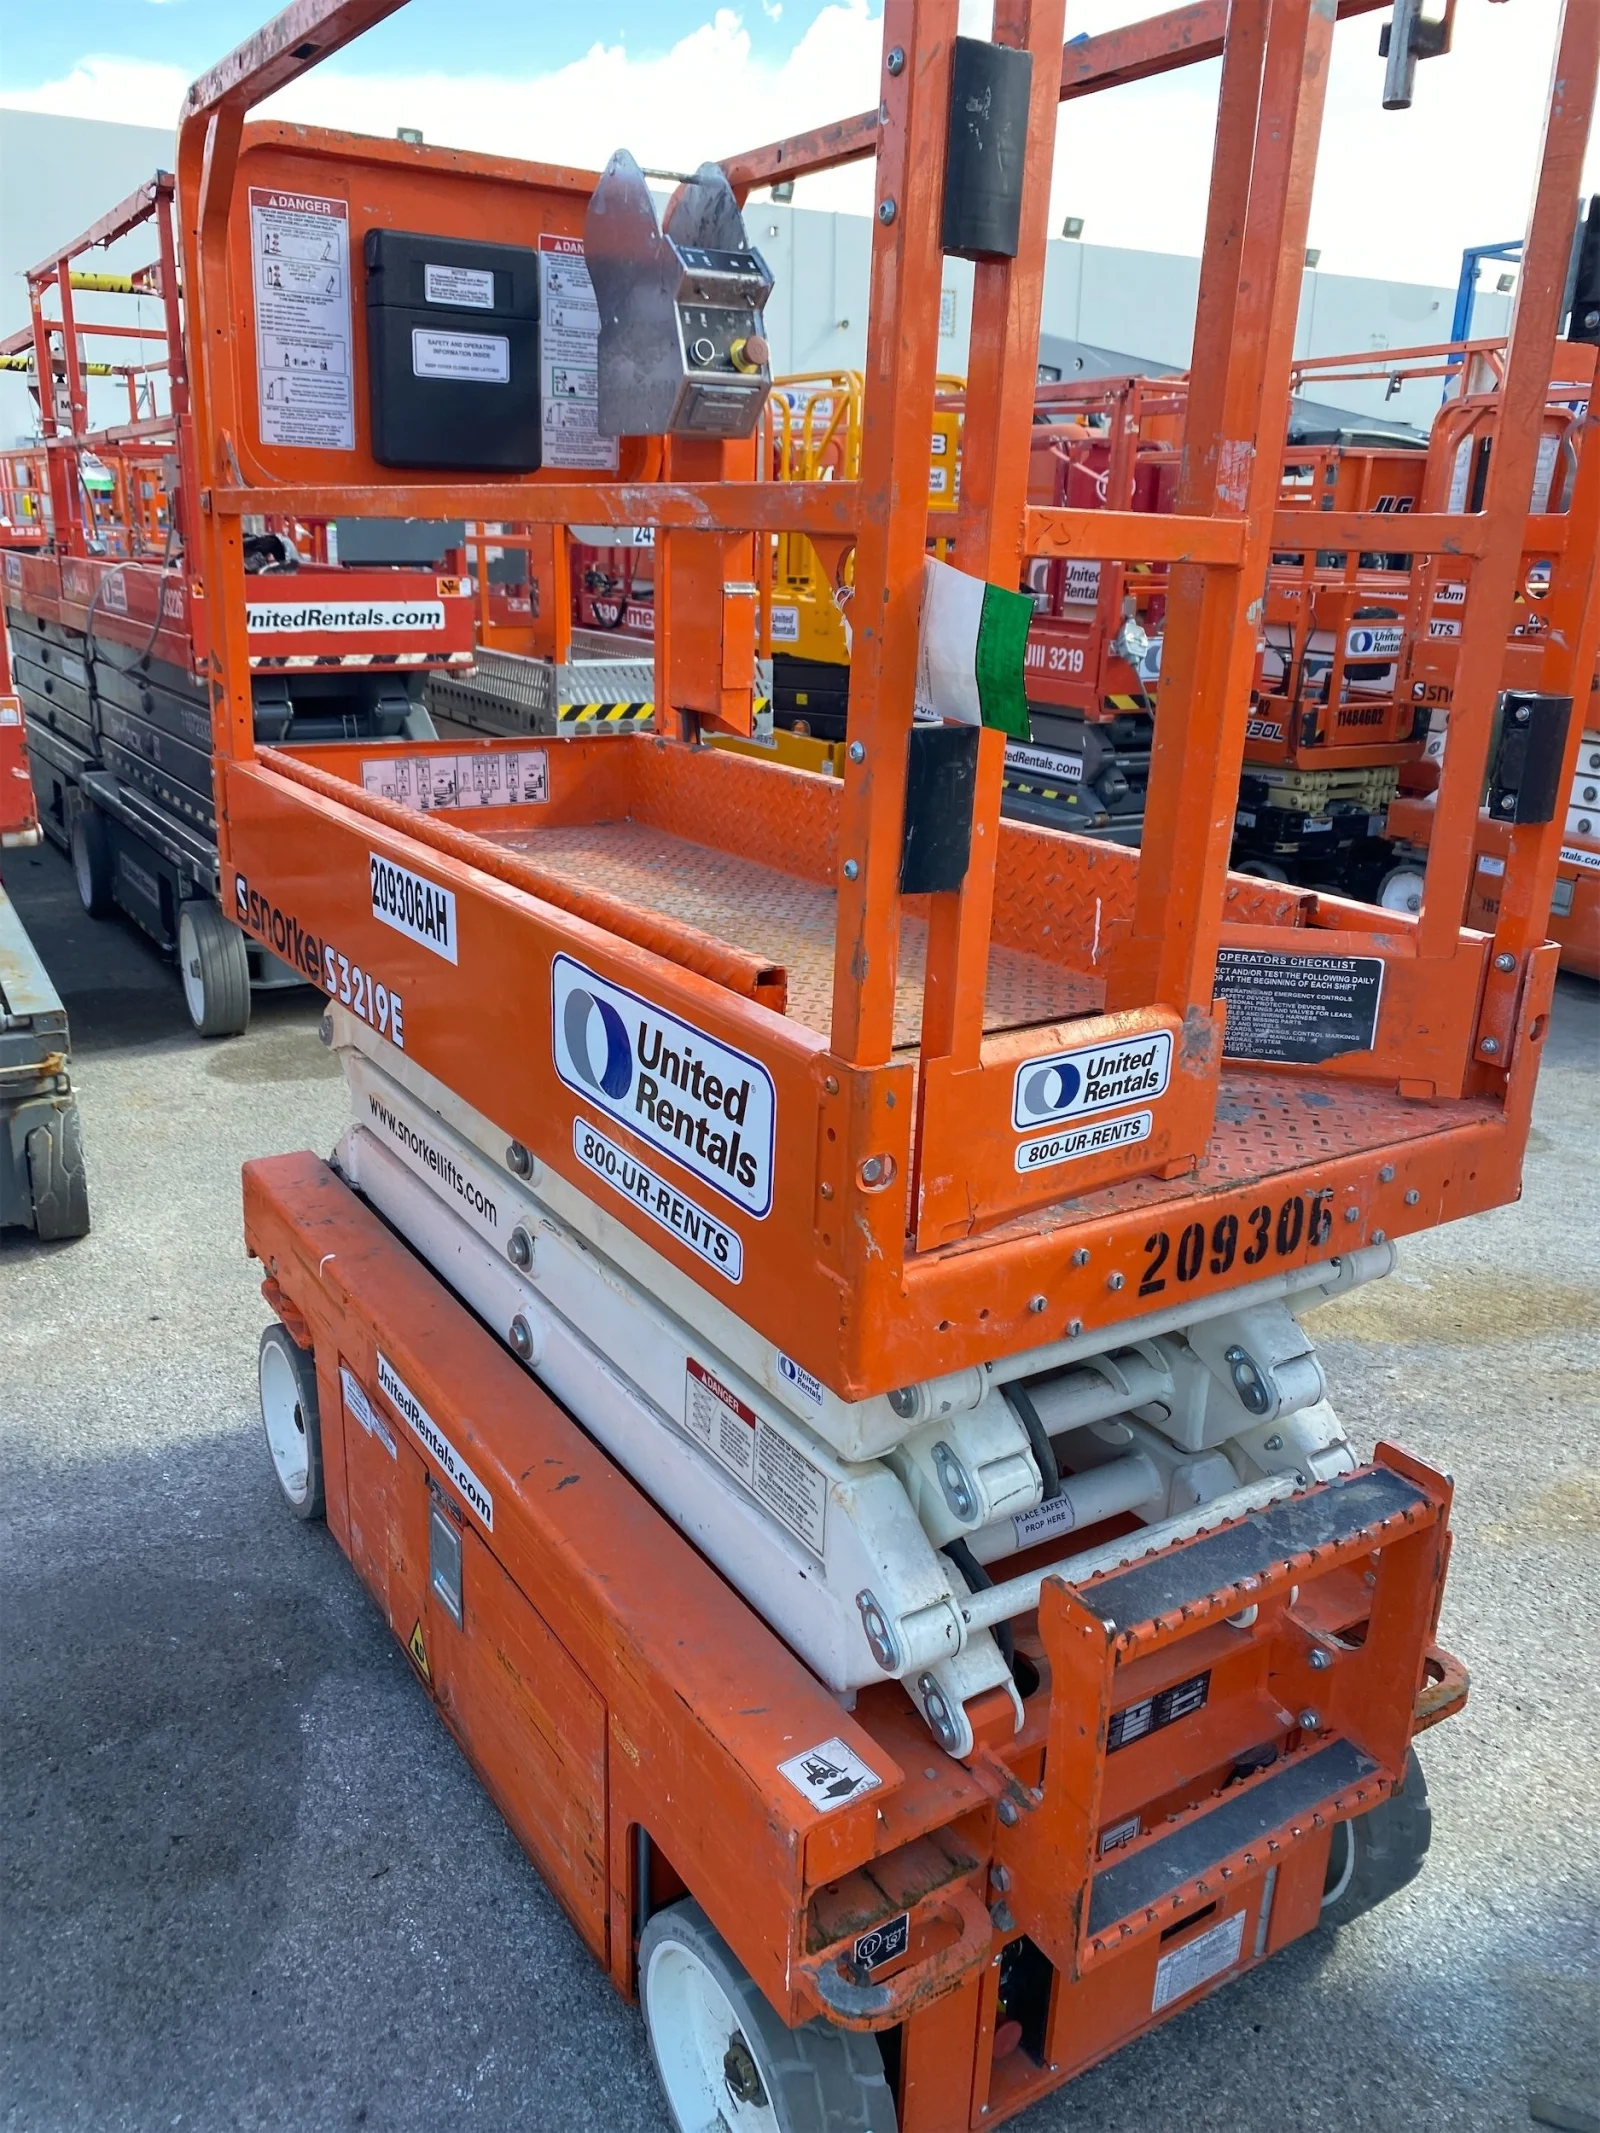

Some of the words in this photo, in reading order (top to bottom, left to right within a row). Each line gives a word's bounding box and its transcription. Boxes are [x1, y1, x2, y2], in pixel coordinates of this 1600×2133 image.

[279, 196, 331, 214] DANGER
[428, 339, 449, 347] SAFETY
[463, 342, 496, 351] OPERATING
[433, 348, 472, 357] INFORMATION
[1048, 646, 1084, 674] 3219
[370, 857, 449, 947] 209306AH
[1219, 952, 1287, 965] OPERATORS
[1290, 957, 1357, 970] CHECKLIST
[1231, 968, 1262, 977] AND/OR
[1264, 970, 1283, 978] TEST
[1285, 972, 1301, 980] THE
[1303, 973, 1350, 983] FOLLOWING
[1352, 976, 1375, 985] DAILY
[1237, 976, 1252, 984] THE
[1253, 977, 1296, 987] BEGINNING
[1298, 980, 1309, 988] OF
[1310, 981, 1333, 989] EACH
[1334, 982, 1357, 991] SHIFT
[323, 944, 405, 1051] S3219E
[1221, 987, 1257, 995] OPERATING
[1274, 991, 1315, 1000] EMERGENCY
[1255, 1001, 1296, 1009] PROTECTIVE
[1244, 1005, 1273, 1013] FITTINGS
[1290, 1008, 1314, 1016] VALVES
[1261, 1011, 1284, 1019] WIRING
[1224, 1035, 1253, 1043] ARDRAIL
[1292, 1030, 1324, 1038] CONTROL
[1325, 1033, 1360, 1041] MARKINGS
[636, 1020, 750, 1127] United
[1086, 1044, 1157, 1081] United
[1083, 1068, 1160, 1104] Rentals
[635, 1071, 758, 1190] Rentals
[1028, 1118, 1142, 1164] 800-UR-RENTS
[368, 1094, 498, 1228] www.snorkellifts.com
[583, 1133, 730, 1263] 800-UR-RENTS
[1138, 1187, 1334, 1297] 209306
[797, 1366, 821, 1391] United
[797, 1376, 822, 1402] Rentals
[706, 1377, 740, 1413] DANGER
[791, 1449, 806, 1466] SAFETY
[1014, 1508, 1040, 1524] PLACE
[1040, 1498, 1068, 1514] SAFETY
[1025, 1520, 1045, 1533] PROP
[1046, 1511, 1066, 1526] HERE
